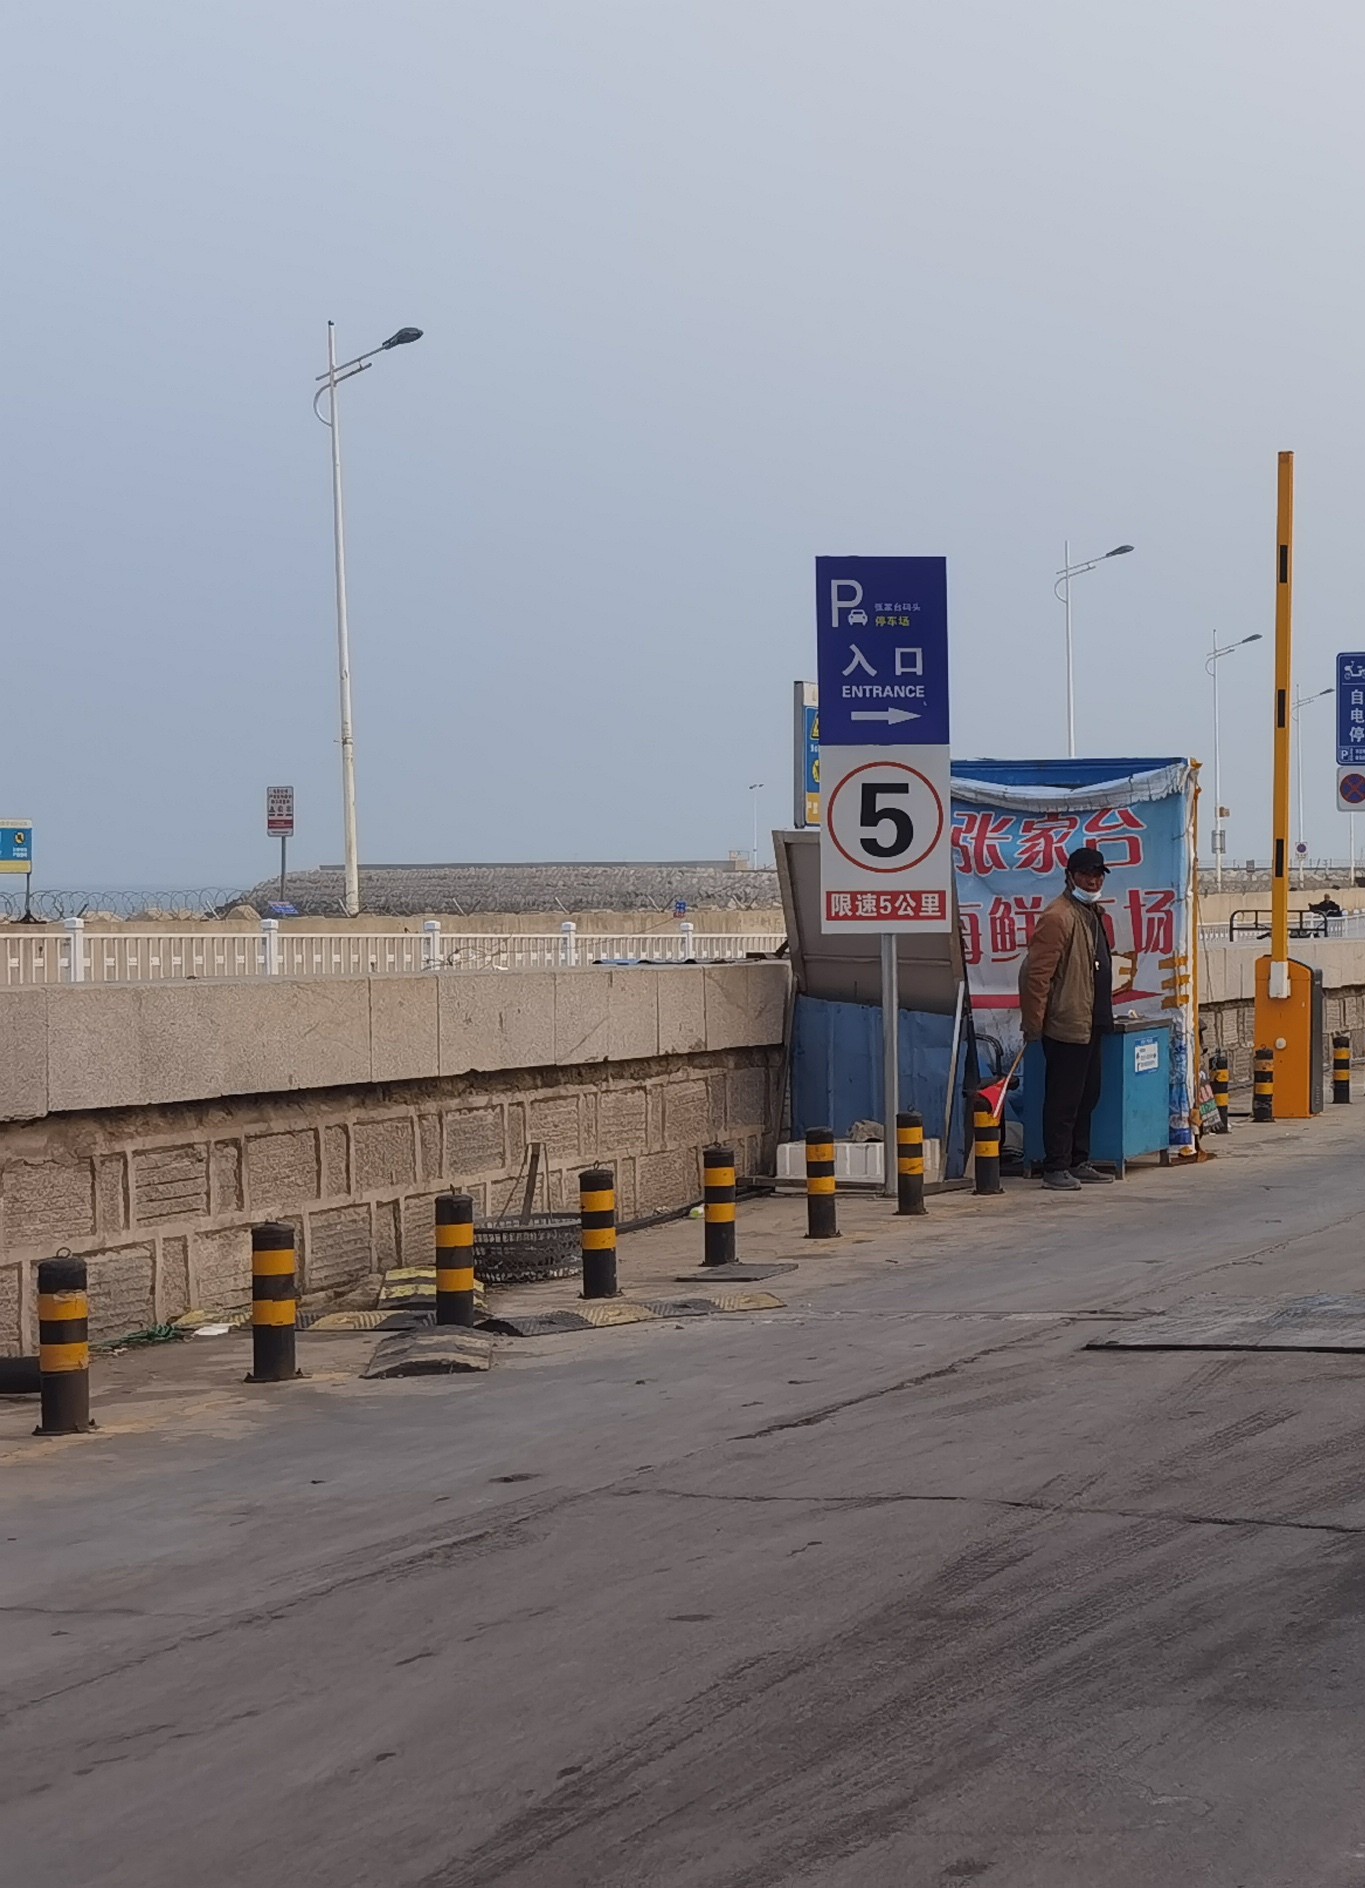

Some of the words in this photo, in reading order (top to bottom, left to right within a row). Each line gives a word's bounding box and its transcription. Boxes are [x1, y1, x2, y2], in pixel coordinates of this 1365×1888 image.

[831, 579, 863, 628] P
[875, 616, 910, 627] 停车场
[842, 644, 923, 677] 入口
[842, 685, 925, 698] ENTRANCE
[860, 783, 914, 857] 5
[951, 808, 1147, 876] 张家台
[831, 893, 941, 916] 限速5公里
[959, 889, 1180, 965] 鲜场
